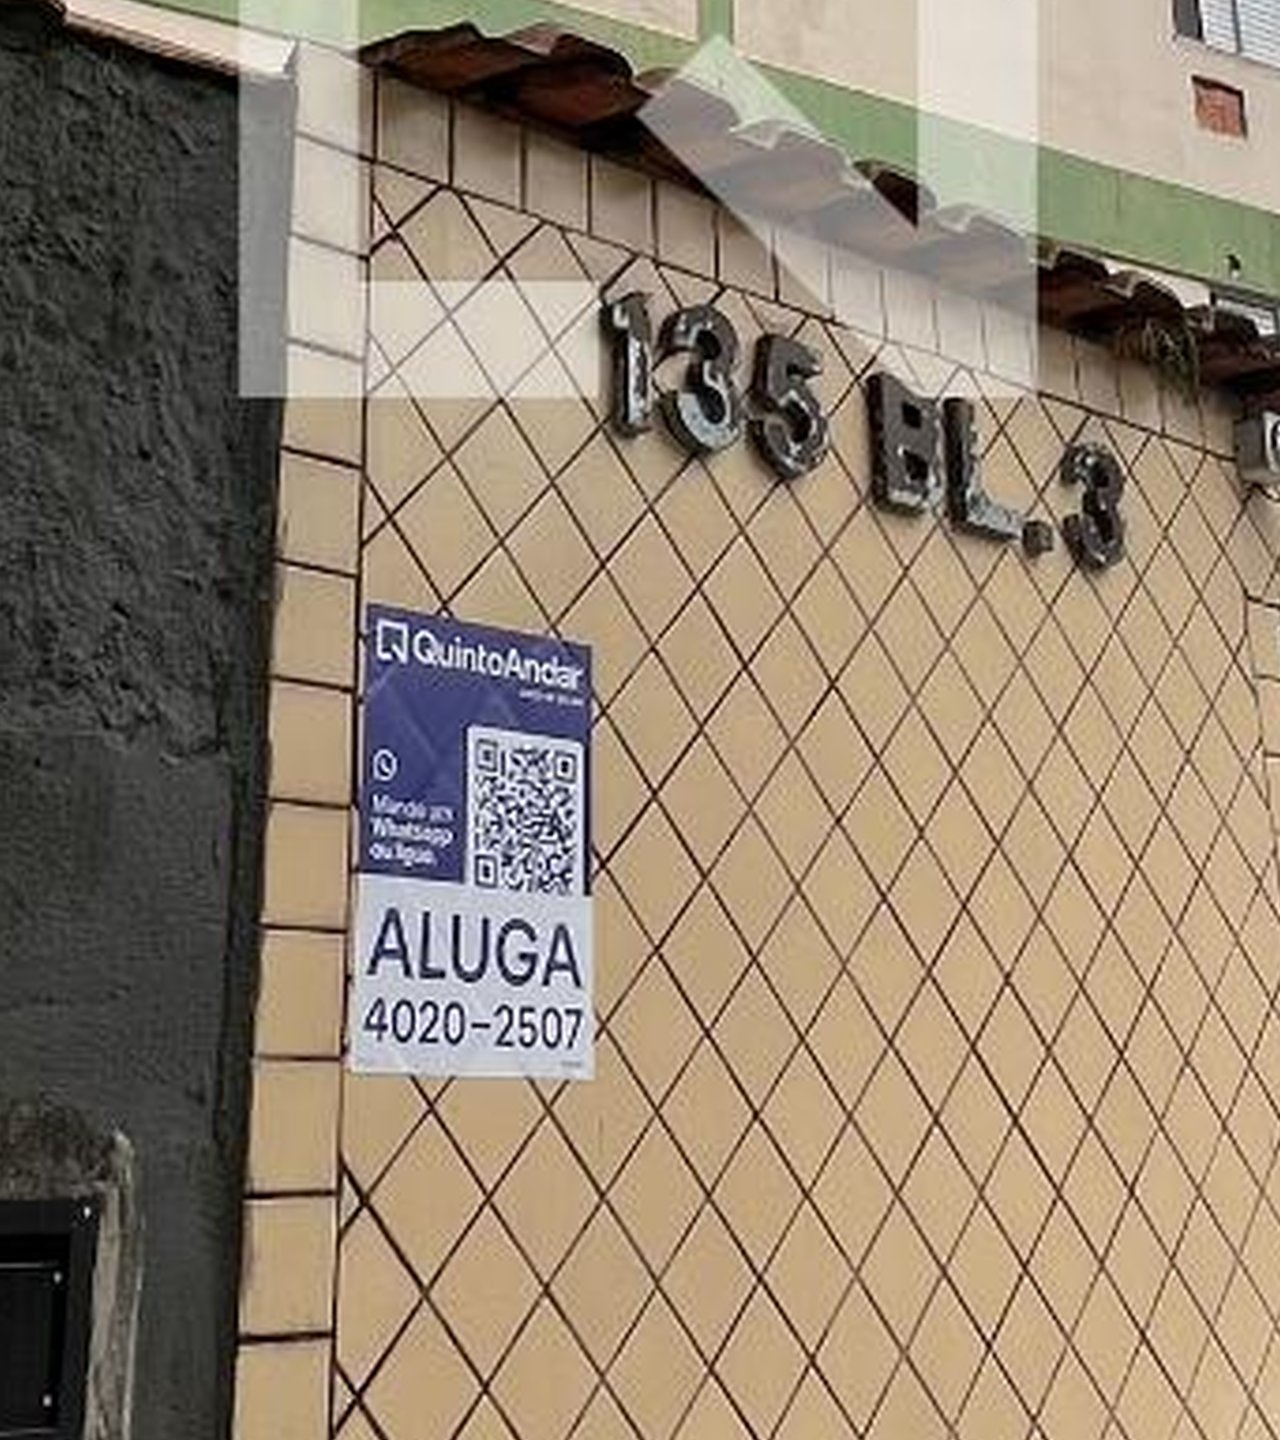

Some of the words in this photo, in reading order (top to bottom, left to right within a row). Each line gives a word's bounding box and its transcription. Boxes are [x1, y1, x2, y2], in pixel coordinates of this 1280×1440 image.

[599, 290, 828, 481] 135
[412, 630, 584, 690] QuintoAndar
[368, 842, 393, 860] ou
[365, 907, 583, 989] ALUGA
[363, 997, 583, 1050] 4020-2507
